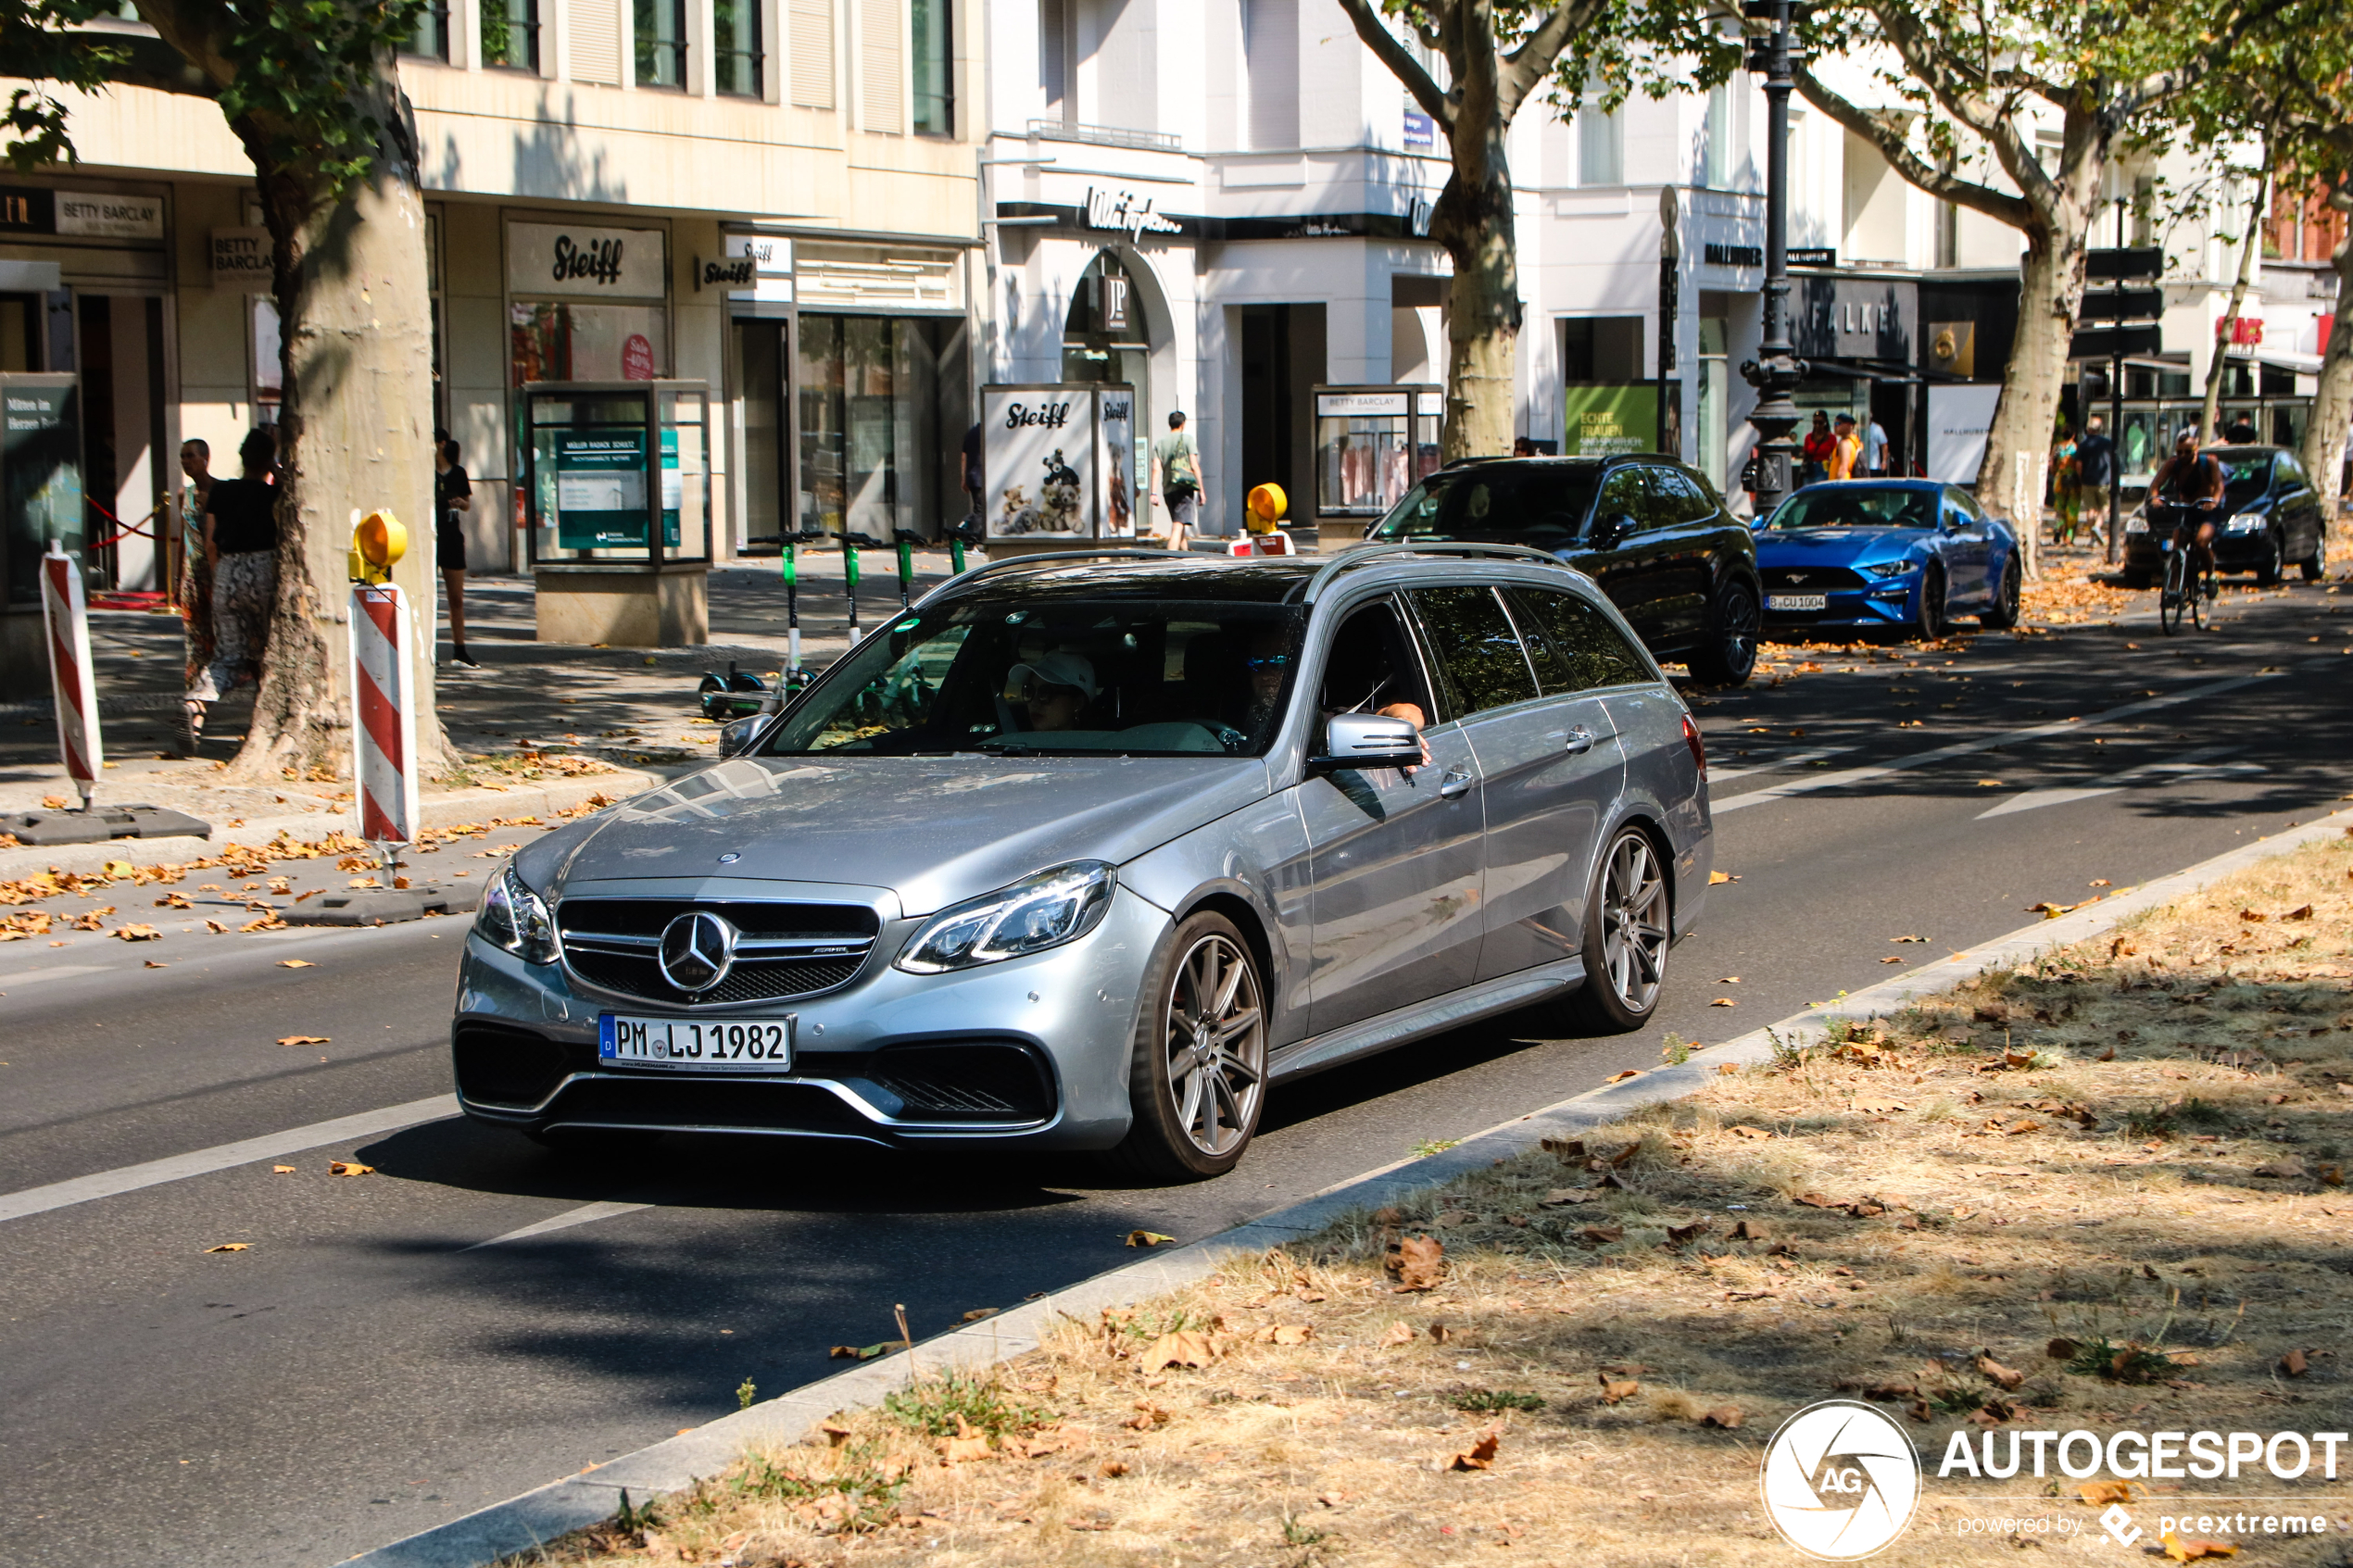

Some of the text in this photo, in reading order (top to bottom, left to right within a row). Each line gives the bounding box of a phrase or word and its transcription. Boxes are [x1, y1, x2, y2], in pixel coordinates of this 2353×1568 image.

[64, 202, 155, 222] BETTY BARCLAY
[215, 237, 259, 254] BETTY
[216, 255, 274, 270] BARCLA
[553, 234, 623, 284] Steiff
[1787, 252, 1828, 262] ALLHUBER
[704, 262, 753, 285] Steiff
[1811, 300, 1890, 334] FALKE
[630, 338, 648, 355] Sale
[1328, 397, 1396, 407] BETTY BARCLAY
[1006, 402, 1070, 430] Steiff
[1104, 401, 1129, 422] Steiff
[1580, 412, 1615, 424] ECHTE
[1580, 425, 1624, 437] FRAUEN
[1770, 597, 1825, 608] B CU 1004
[605, 1041, 612, 1051] D
[617, 1021, 784, 1059] PM LJ 1982
